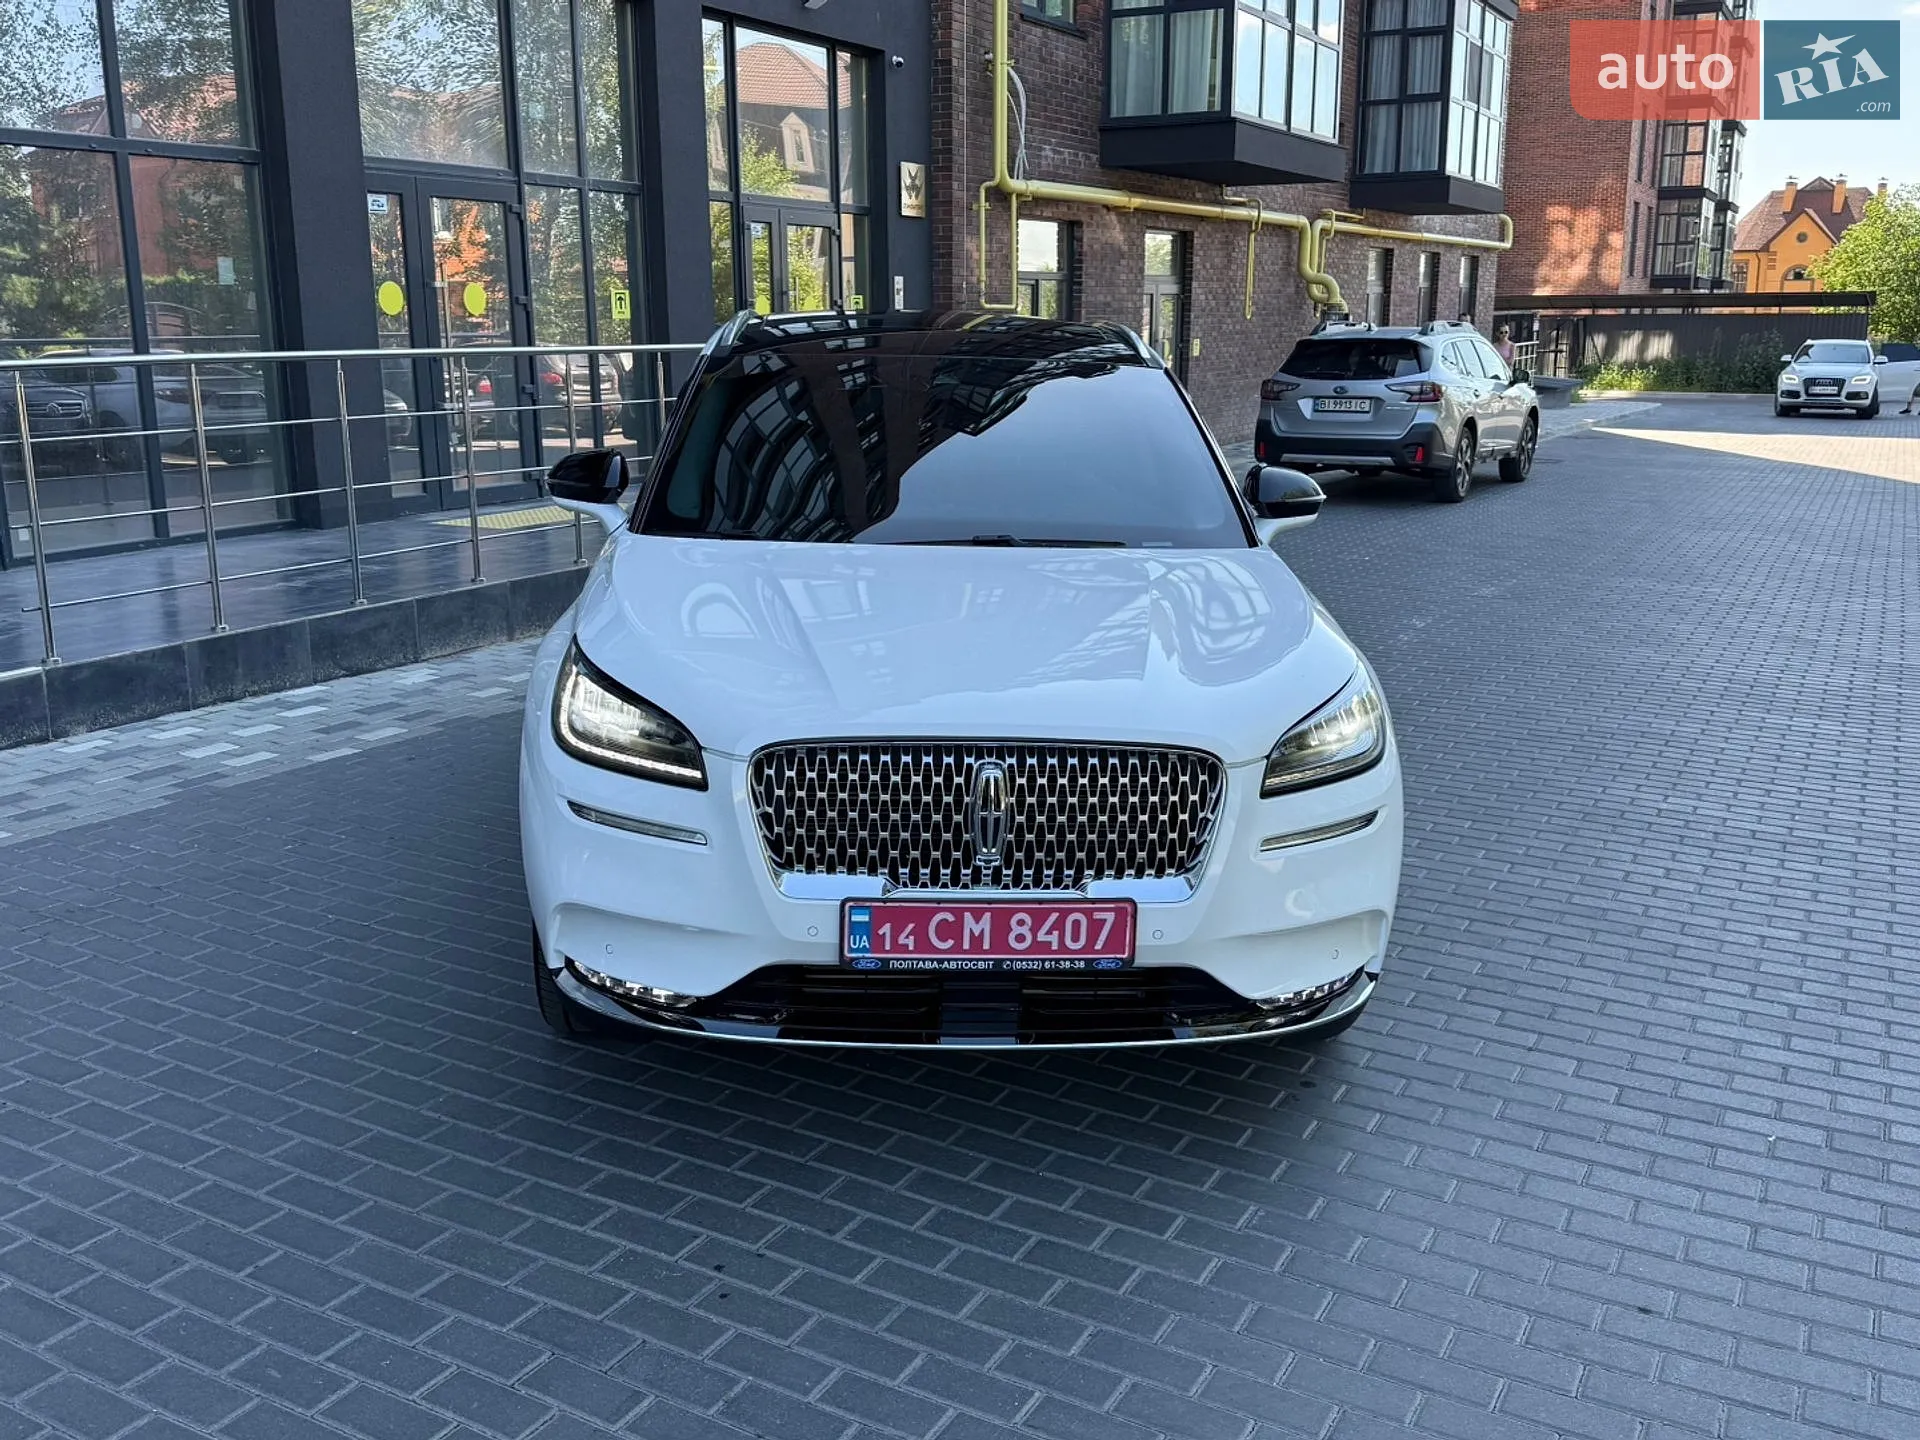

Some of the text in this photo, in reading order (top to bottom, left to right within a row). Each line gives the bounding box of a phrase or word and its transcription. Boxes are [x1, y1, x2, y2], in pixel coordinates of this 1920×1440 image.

[877, 912, 1116, 951] 14 CM 8407
[850, 935, 870, 949] UA
[889, 960, 994, 969] ПОЛТАВА-АВТОСВІТ
[1012, 960, 1086, 970] (0532) 61-38-38
